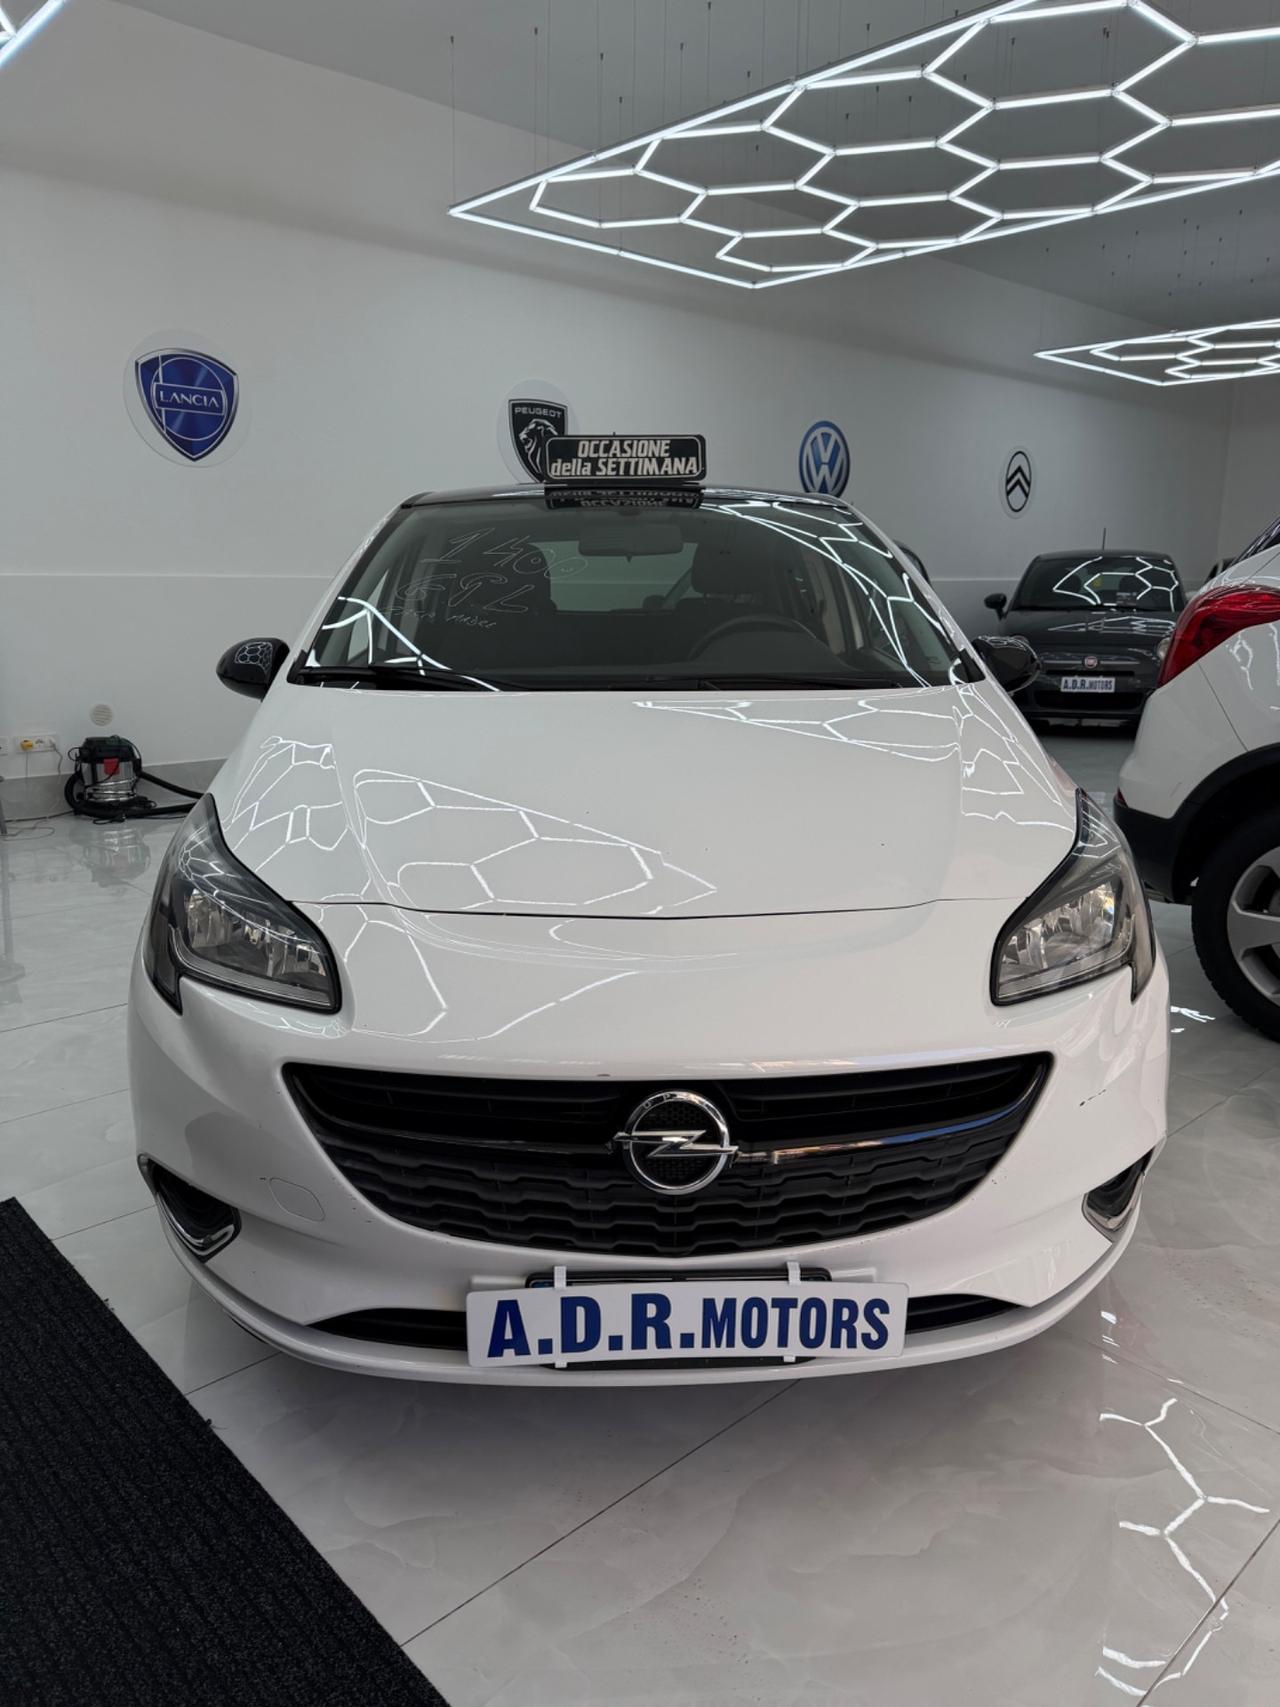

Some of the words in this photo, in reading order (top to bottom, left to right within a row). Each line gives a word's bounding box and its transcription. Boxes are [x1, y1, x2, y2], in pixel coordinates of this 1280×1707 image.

[160, 390, 219, 408] LANCIA
[514, 407, 562, 418] PEUGEOT
[577, 439, 671, 458] OCCASIONE
[550, 458, 592, 476] della
[595, 456, 698, 476] SETTIMANA
